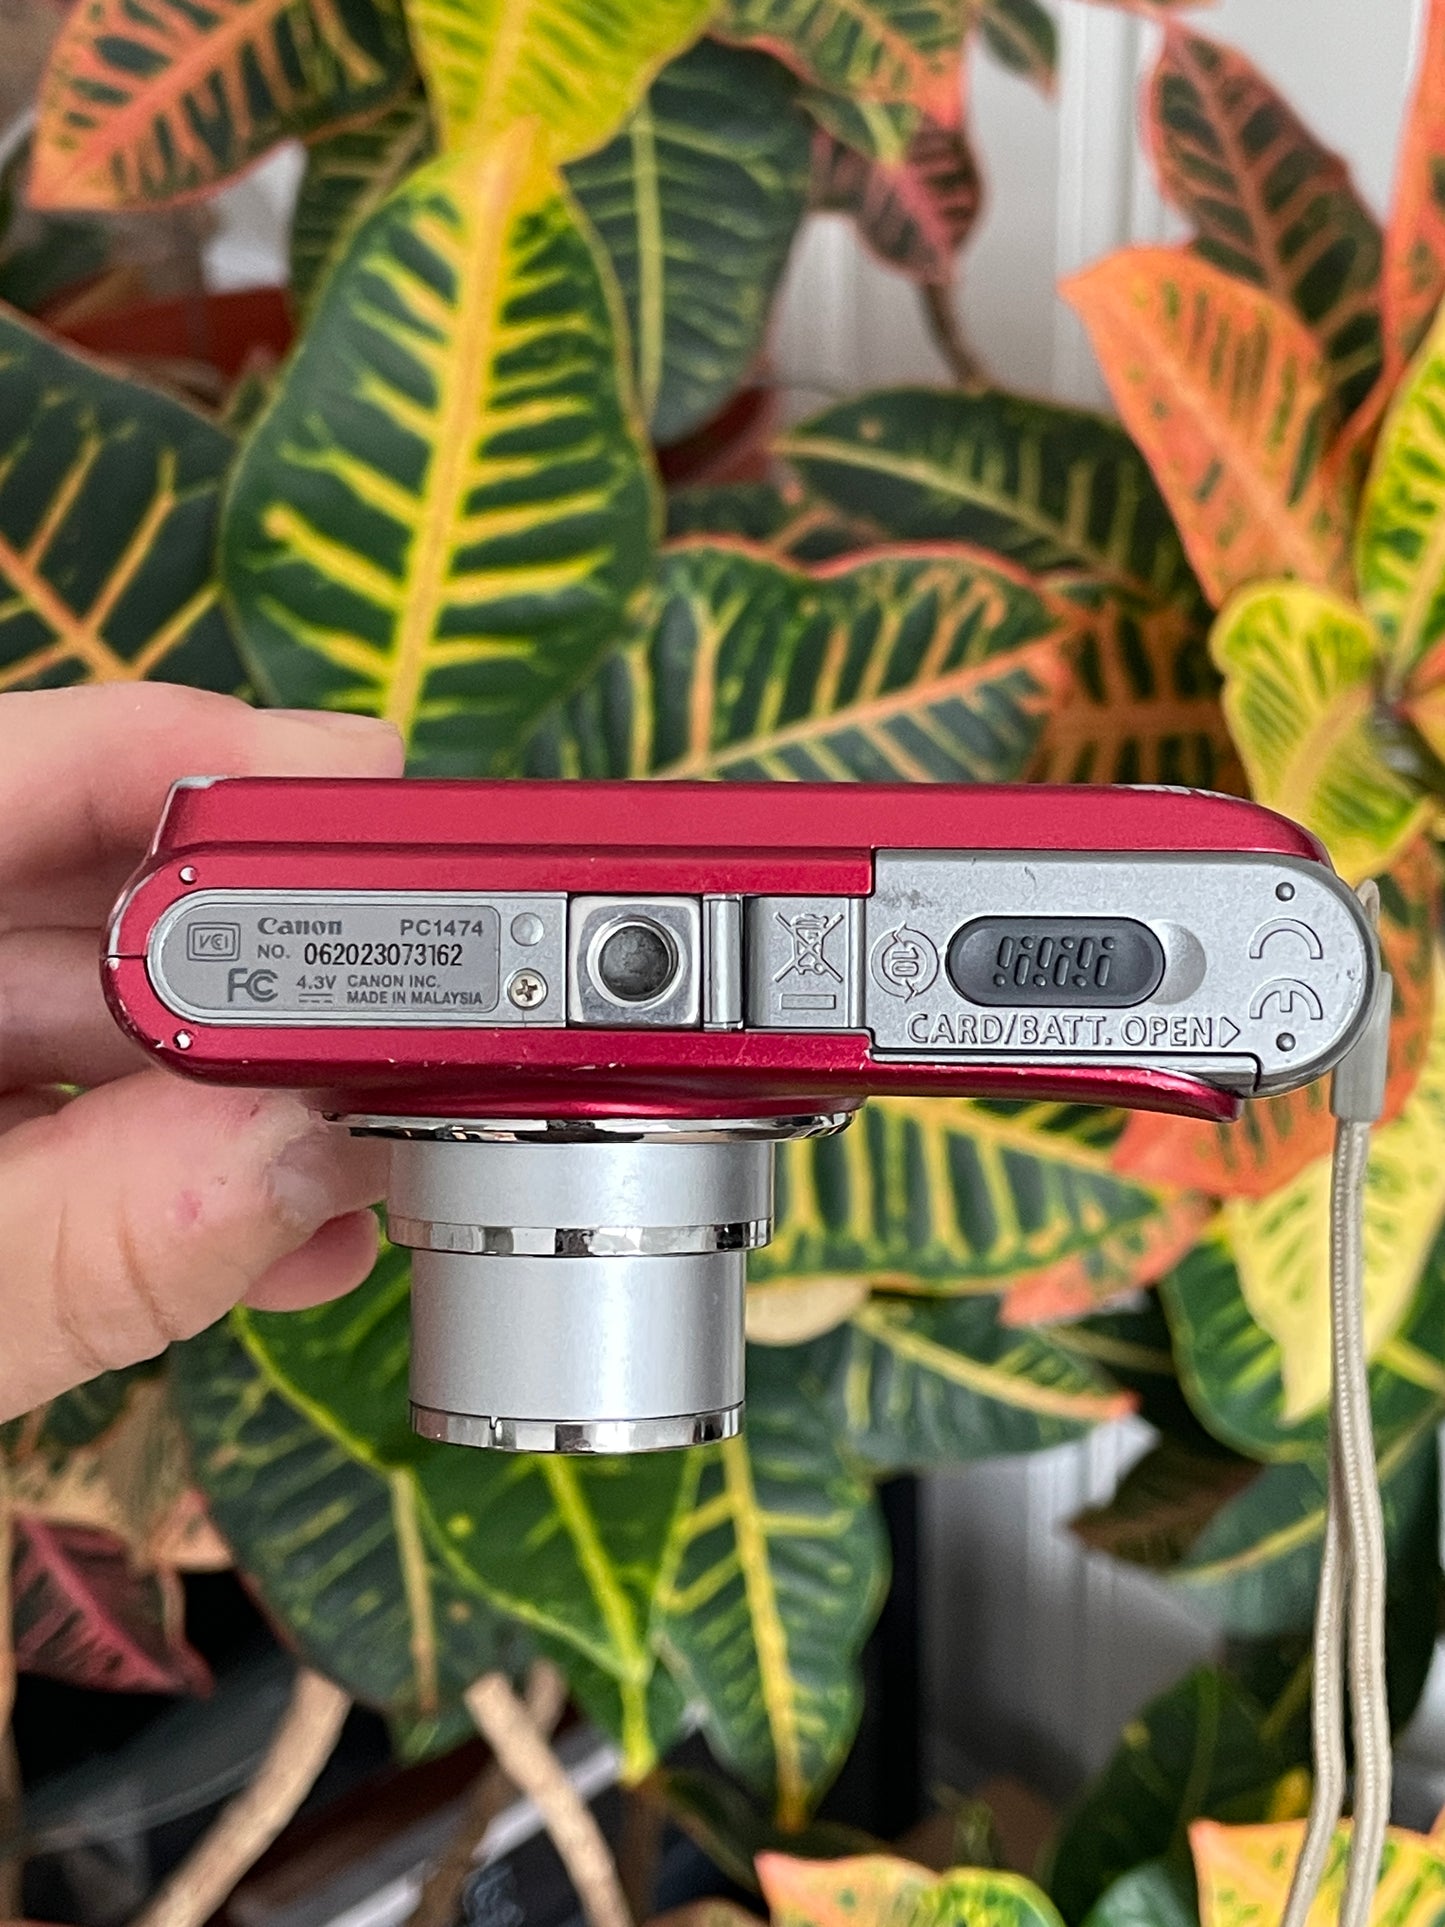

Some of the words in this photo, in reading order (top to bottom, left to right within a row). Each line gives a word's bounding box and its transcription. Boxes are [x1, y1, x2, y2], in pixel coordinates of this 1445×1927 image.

[257, 917, 343, 935] Canon
[400, 919, 483, 936] PC1474
[257, 944, 291, 959] NO.
[304, 942, 463, 966] 062023073162
[296, 975, 337, 990] 4.3V
[347, 975, 404, 988] CANON
[409, 975, 441, 988] INC.
[347, 991, 387, 1004] MADE
[391, 991, 406, 1004] IN
[411, 991, 482, 1004] MALAYSIA
[907, 1014, 1112, 1046] CARD/BATT.
[1120, 1016, 1213, 1047] OPEN
